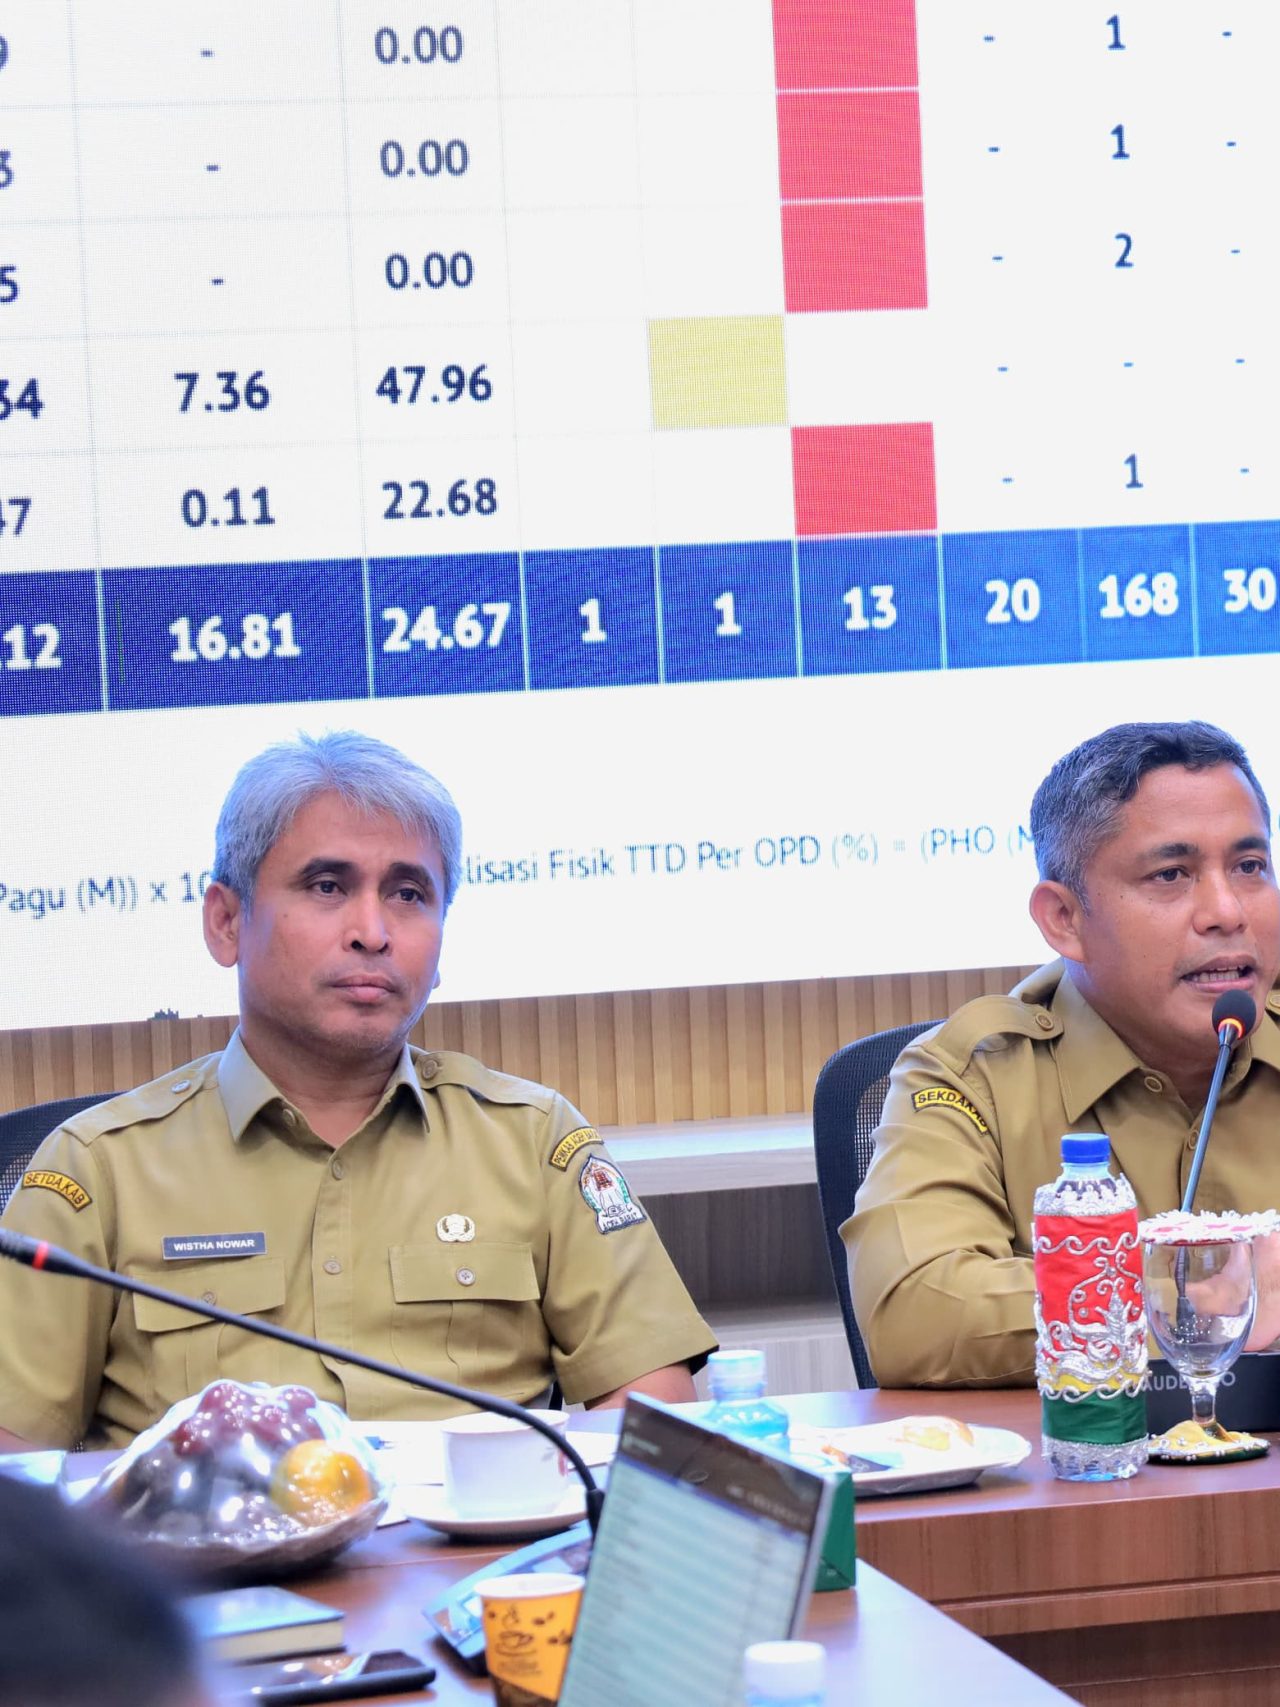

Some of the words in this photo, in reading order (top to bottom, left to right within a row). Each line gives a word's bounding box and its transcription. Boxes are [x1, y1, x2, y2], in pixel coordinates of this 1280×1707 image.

[374, 24, 465, 65] 0.00
[1105, 14, 1127, 51] 1
[379, 138, 470, 179] 0.00
[1110, 123, 1131, 161] 1
[384, 250, 475, 291] 0.00
[1114, 232, 1135, 270] 2
[173, 369, 272, 415] 7.36
[375, 363, 494, 406] 47.96
[180, 485, 276, 529] 0.11
[381, 477, 498, 521] 22.68
[1123, 453, 1144, 490] 1
[0, 623, 62, 671] 12
[168, 612, 302, 662] 16.81
[381, 602, 511, 653] 24.67
[580, 598, 607, 643] 1
[714, 592, 742, 637] 1
[843, 584, 897, 631] 13
[985, 578, 1041, 624] 20
[1098, 572, 1179, 619] 168
[1223, 567, 1277, 613] 30
[76, 873, 138, 915] (M))
[148, 880, 168, 904] x
[465, 852, 539, 887] lisasi
[547, 847, 615, 881] Fisik
[623, 842, 688, 876] TTD
[696, 839, 743, 872] Per
[753, 834, 822, 869] OPD
[831, 832, 879, 870] (%)
[920, 824, 997, 864] (PHO
[173, 1241, 215, 1252] WISTHA
[215, 1239, 256, 1250] NOWAR
